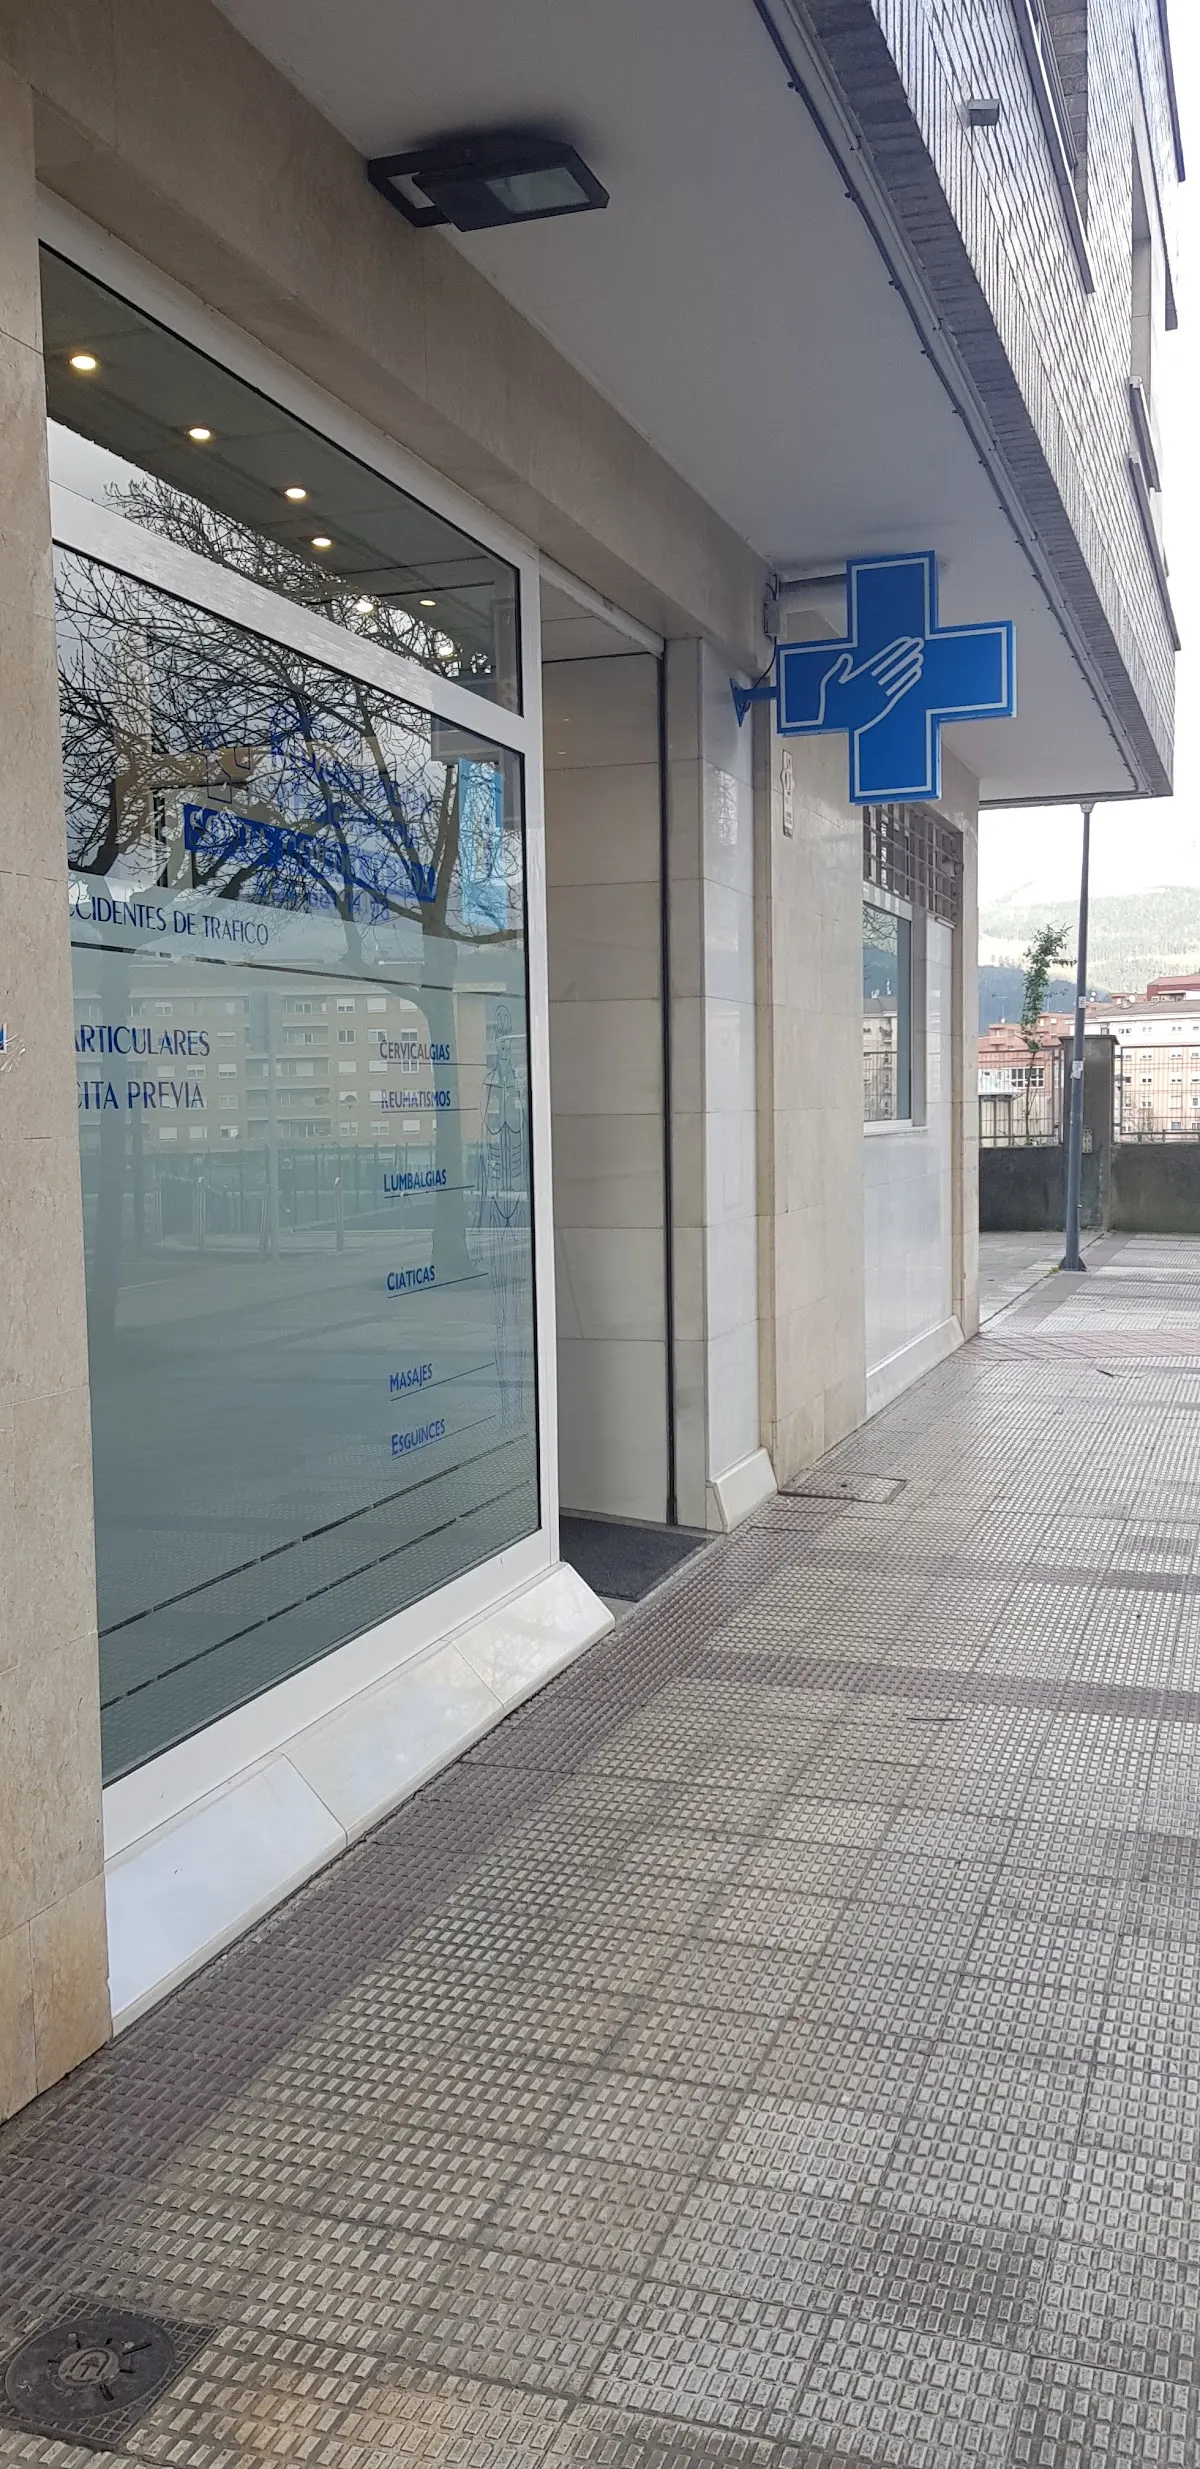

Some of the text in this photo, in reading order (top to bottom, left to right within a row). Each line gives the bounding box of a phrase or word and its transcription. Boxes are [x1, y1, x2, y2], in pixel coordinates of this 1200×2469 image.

[70, 896, 269, 946] CIDENTES DE TRAFICO
[74, 1024, 210, 1057] RTICULARES
[380, 1042, 450, 1061] CERVICALGIAS
[128, 1081, 205, 1110] PREVIA
[381, 1089, 451, 1109] REUMATISMOS
[383, 1169, 447, 1193] LUMBALGIAS
[389, 1363, 433, 1393] MASAJES
[391, 1418, 446, 1456] ESGUINCES
